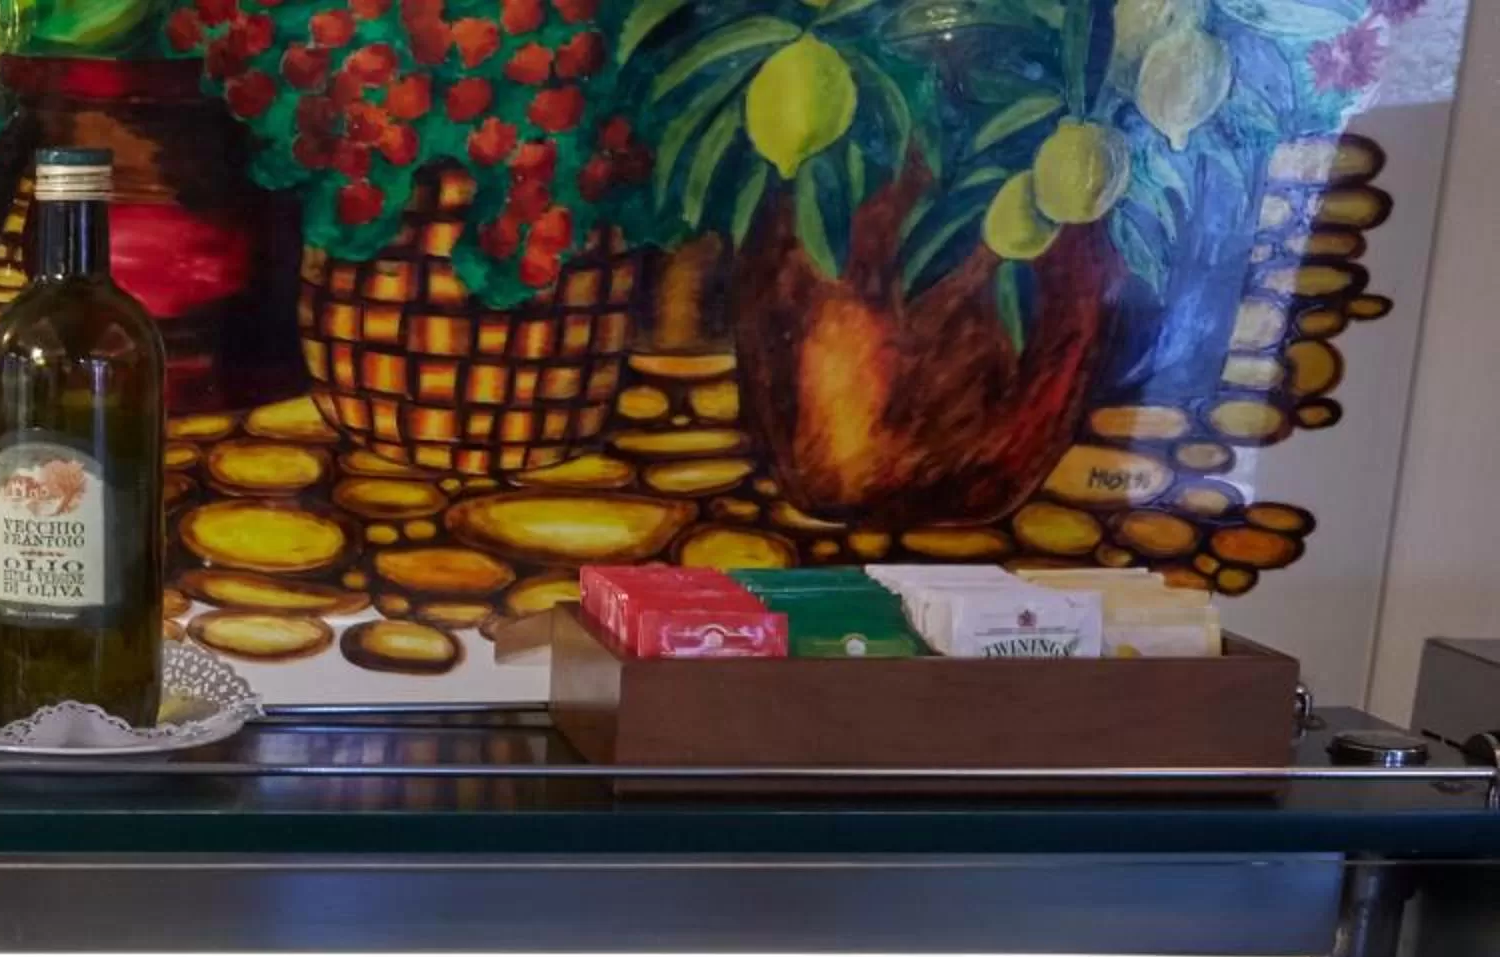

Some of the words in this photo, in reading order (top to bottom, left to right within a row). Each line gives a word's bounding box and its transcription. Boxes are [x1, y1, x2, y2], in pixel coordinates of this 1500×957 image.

[3, 518, 85, 535] VECCHIO
[3, 556, 85, 573] OLIO
[27, 584, 84, 598] OLIVA
